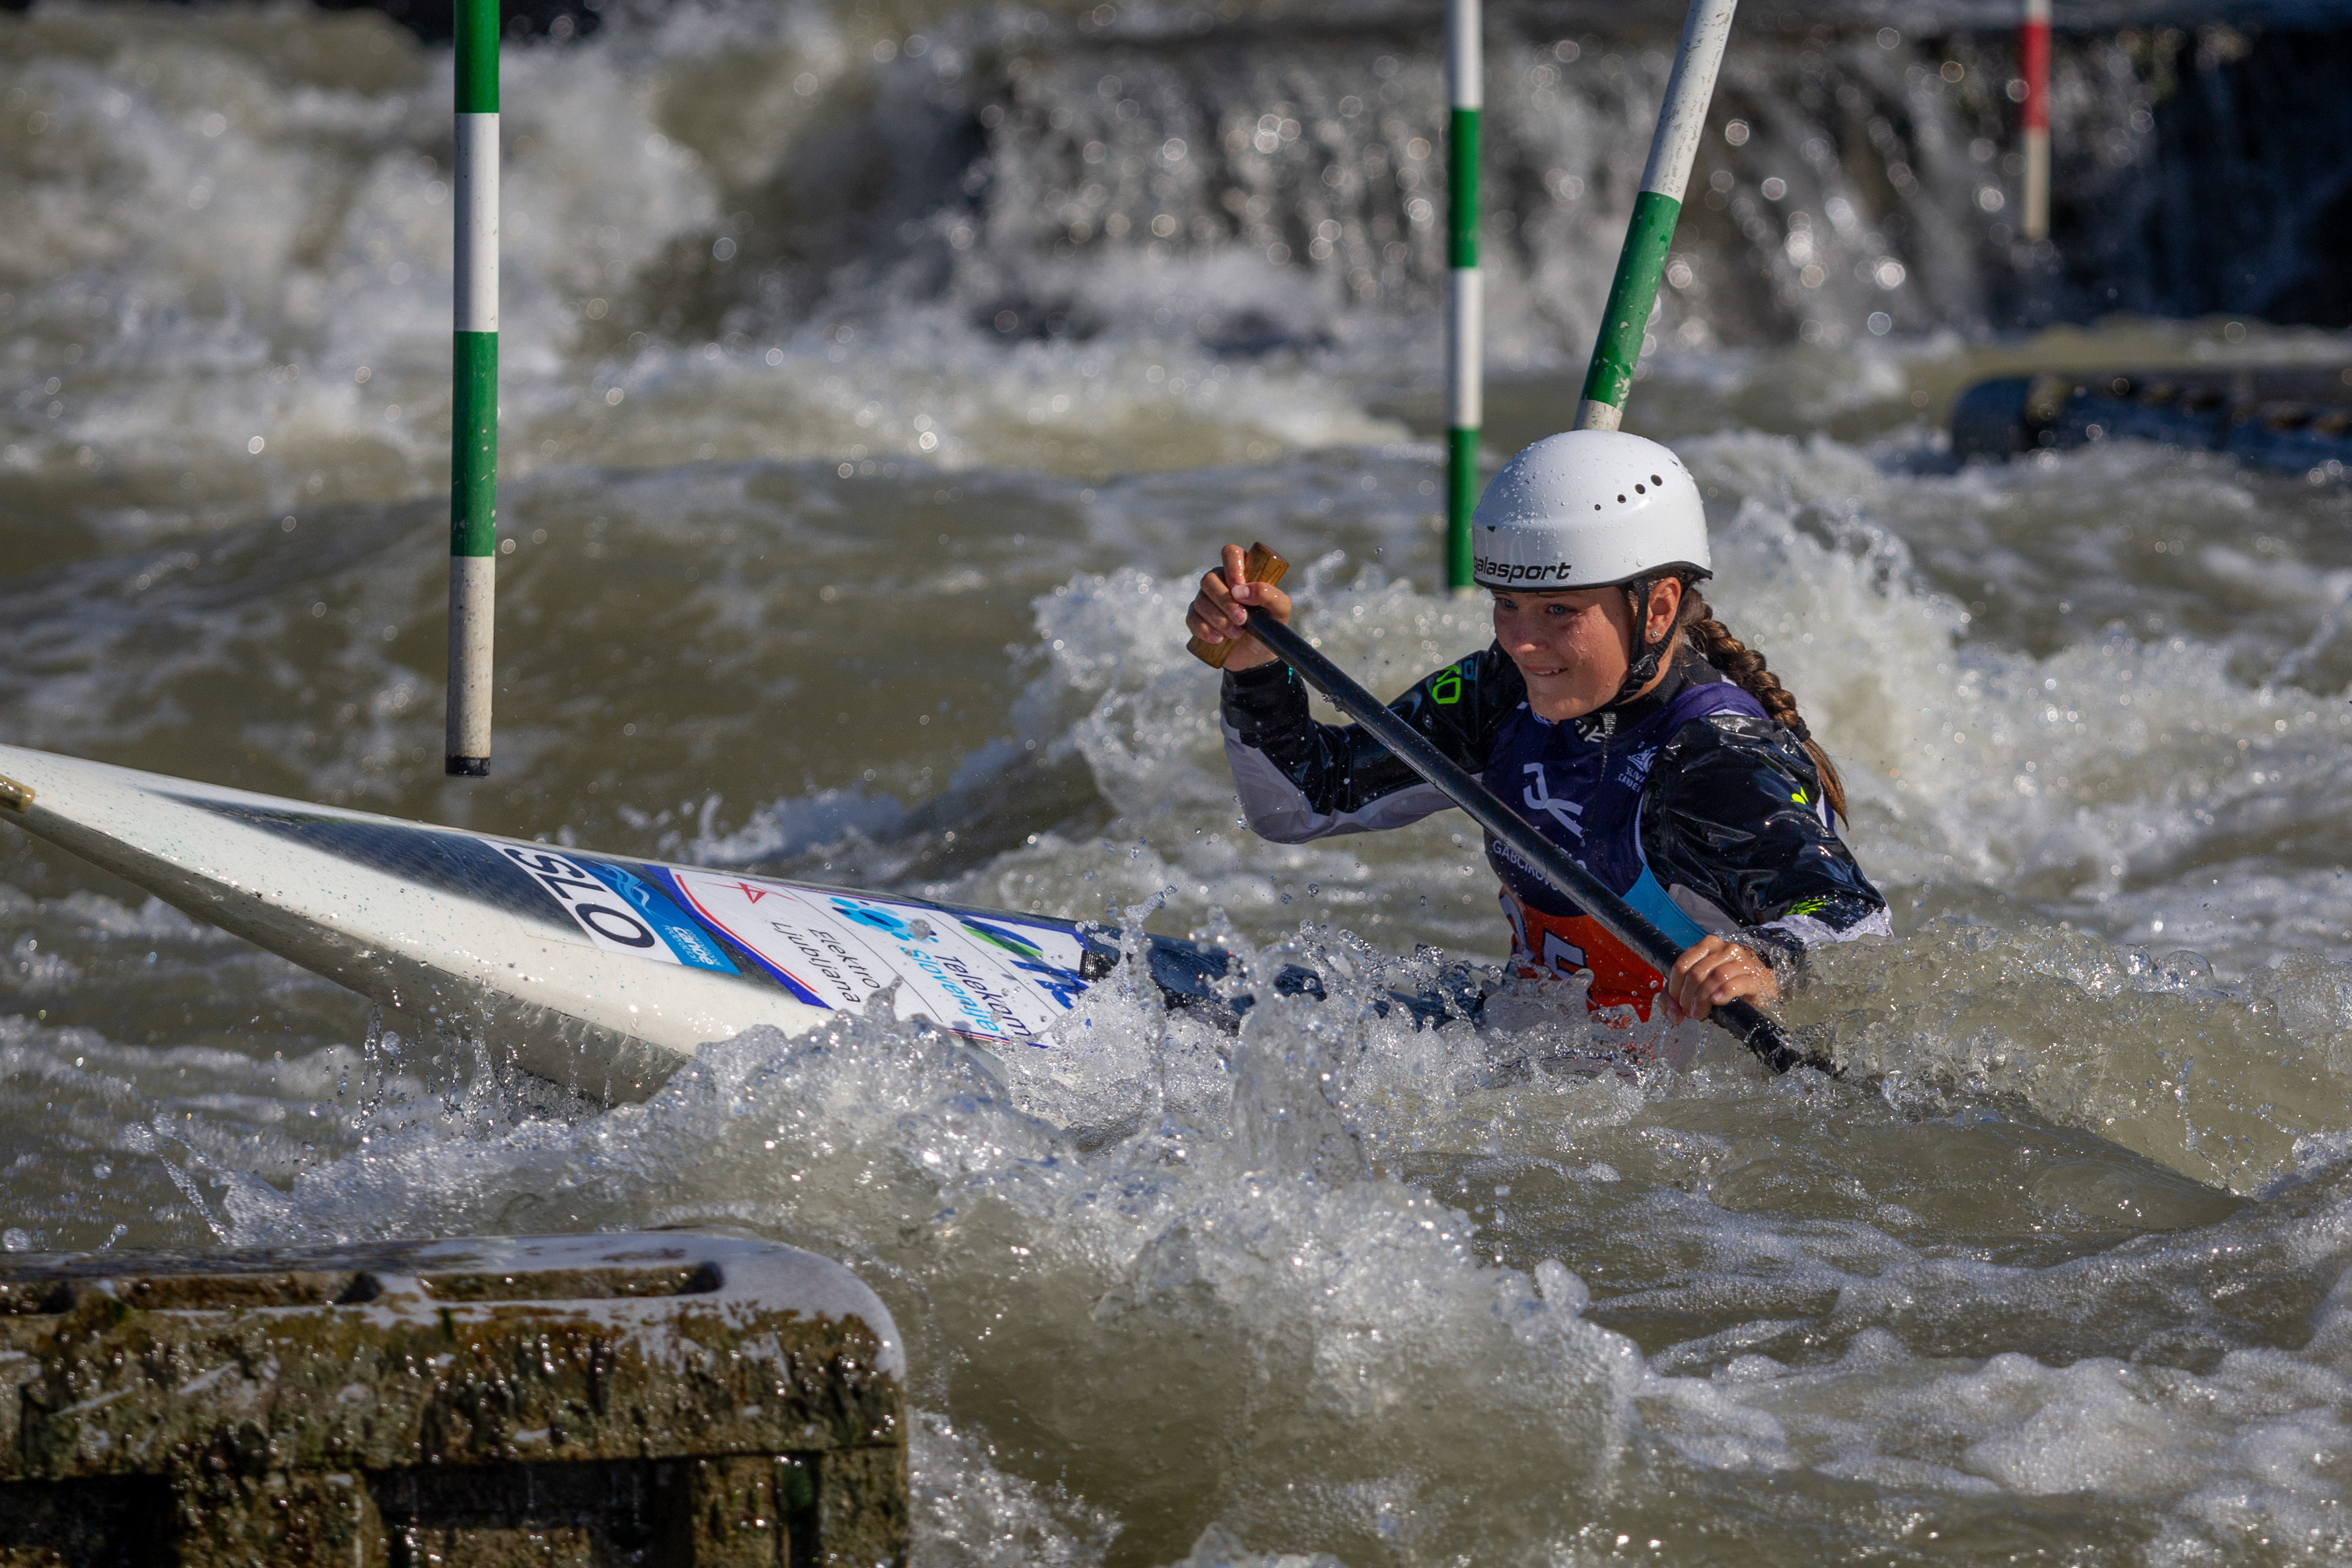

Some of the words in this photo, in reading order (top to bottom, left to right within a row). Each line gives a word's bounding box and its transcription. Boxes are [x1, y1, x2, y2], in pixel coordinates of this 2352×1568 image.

[503, 848, 655, 948] SLO
[672, 926, 714, 965] canoe
[770, 922, 861, 1003] Ljubljana
[807, 928, 880, 989] Elektro
[899, 946, 999, 1032] Slovenije
[934, 955, 1032, 1036] Telekom
